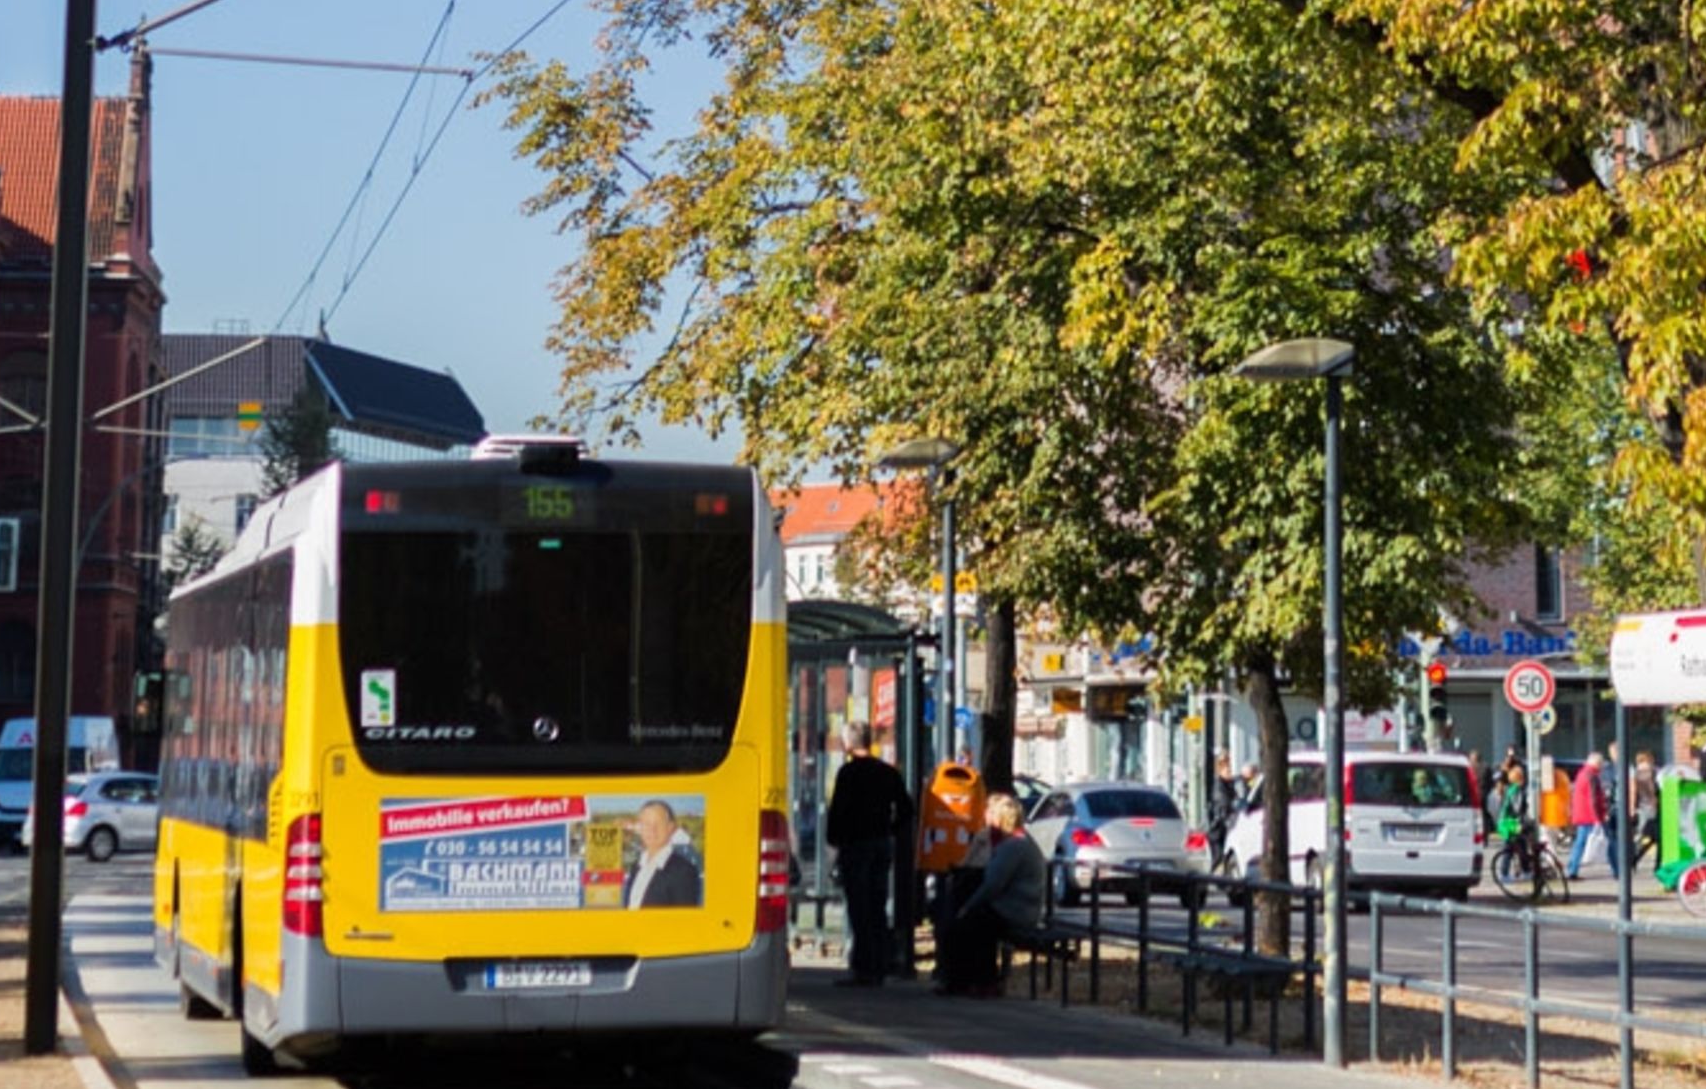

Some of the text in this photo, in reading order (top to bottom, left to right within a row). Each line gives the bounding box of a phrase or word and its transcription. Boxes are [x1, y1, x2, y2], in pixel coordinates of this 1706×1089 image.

[521, 485, 575, 519] 155
[1517, 676, 1543, 697] 50
[365, 725, 476, 740] CITARO
[387, 798, 570, 833] Immobilie verkaufen?
[436, 839, 465, 856] 030
[478, 839, 497, 855] 56
[500, 839, 519, 855] 54
[522, 839, 541, 855] 54
[544, 838, 563, 854] 54
[448, 862, 580, 881] BACHMANN
